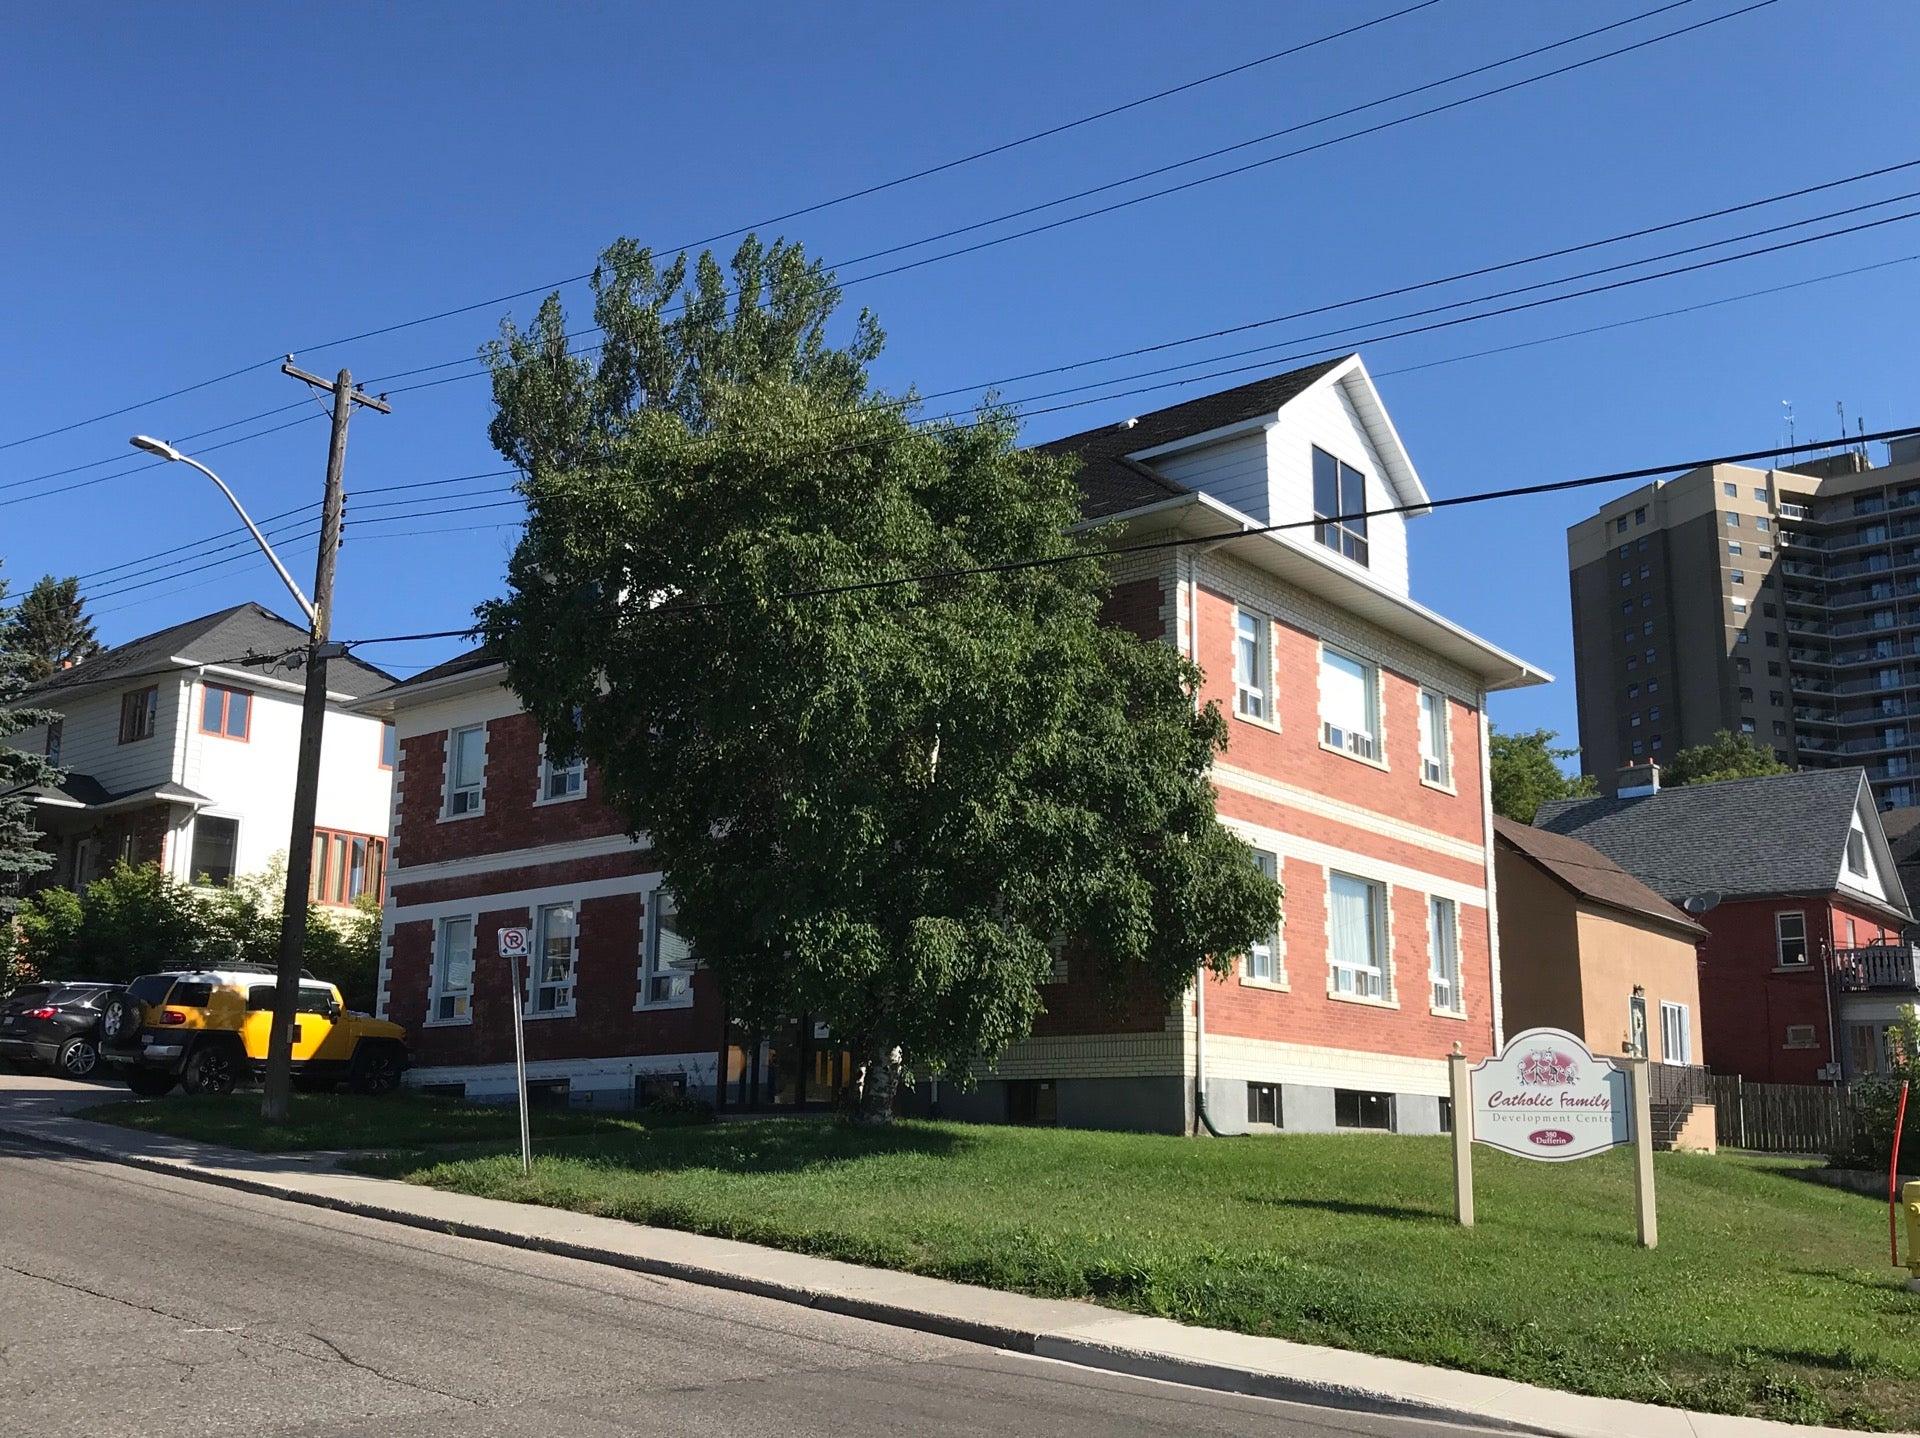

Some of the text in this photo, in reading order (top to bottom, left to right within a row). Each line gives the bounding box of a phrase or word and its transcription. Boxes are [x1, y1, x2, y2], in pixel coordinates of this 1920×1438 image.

[1488, 1090, 1610, 1111] Catholic Family
[1492, 1112, 1615, 1124] Development Centre
[1535, 1136, 1566, 1144] Dufferin
